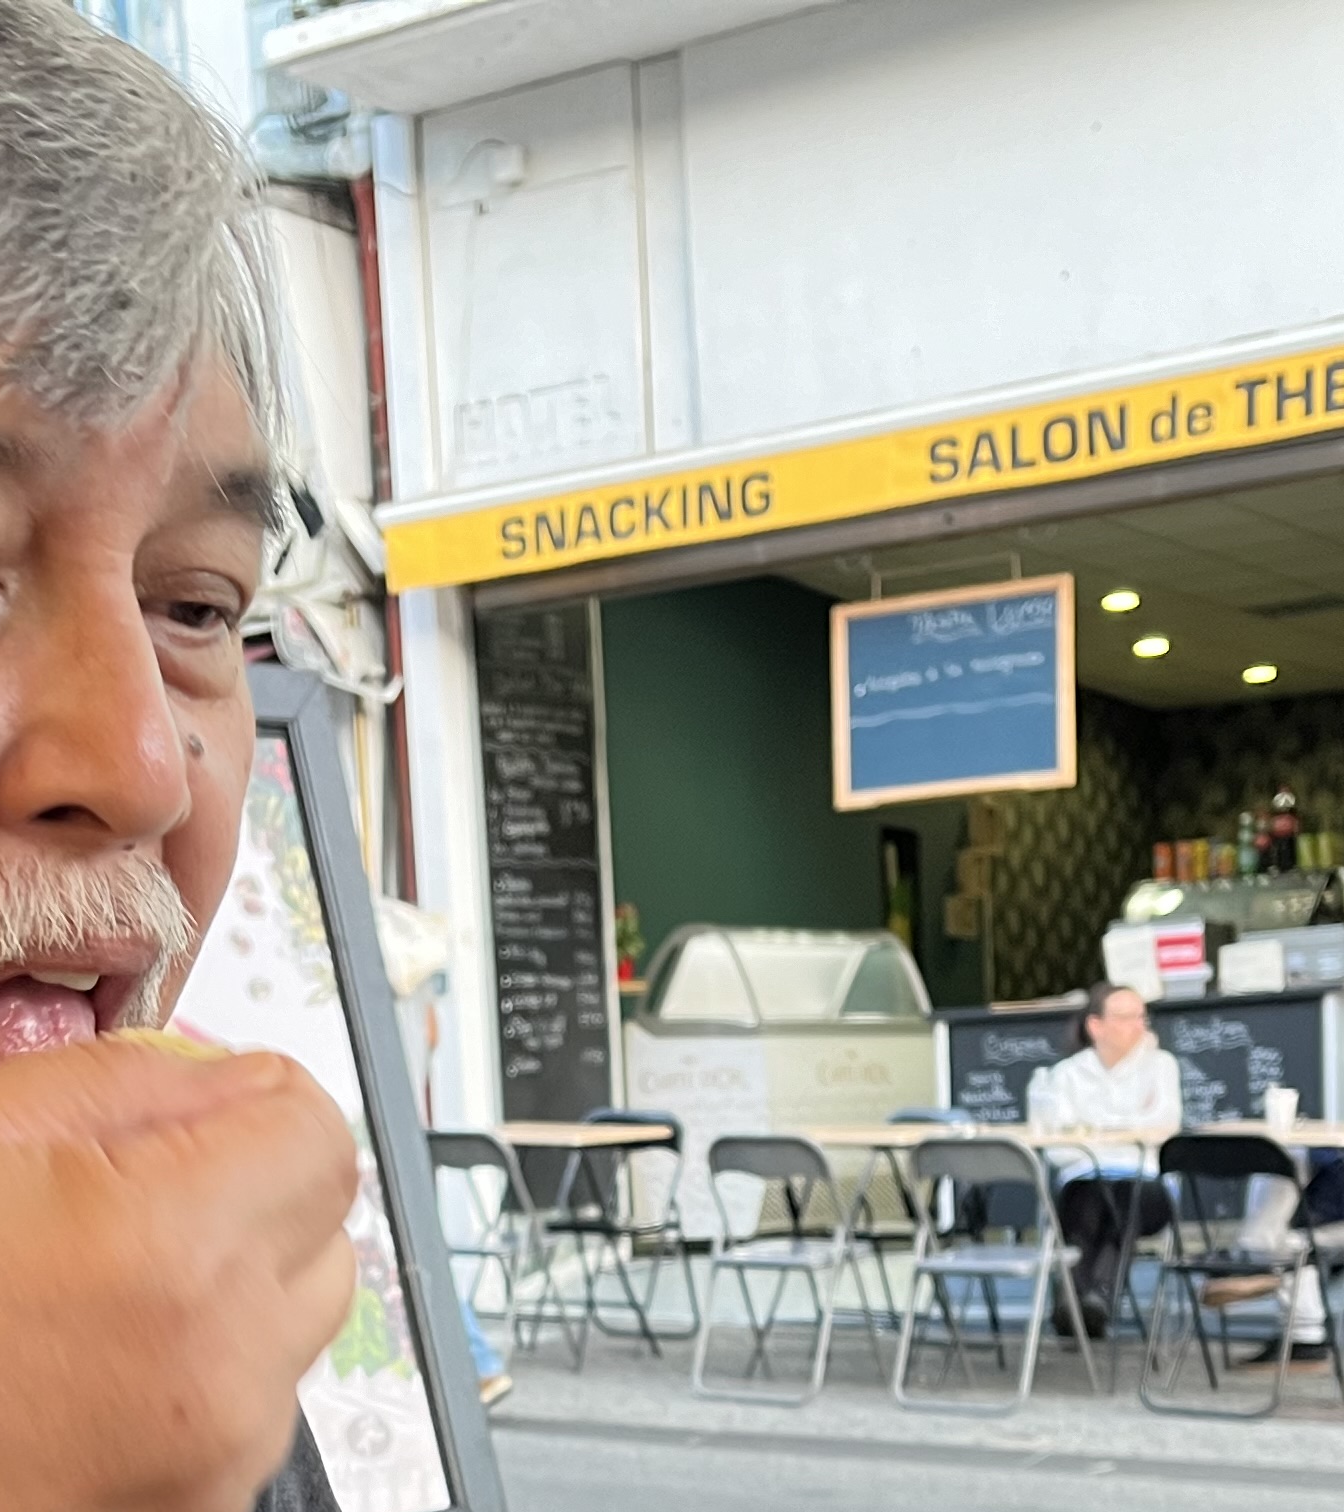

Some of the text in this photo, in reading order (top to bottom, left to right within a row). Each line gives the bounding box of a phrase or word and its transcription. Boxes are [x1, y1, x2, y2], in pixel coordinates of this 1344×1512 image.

[928, 403, 1128, 484] SALON
[1150, 393, 1213, 444] de
[501, 472, 774, 560] SNACKING
